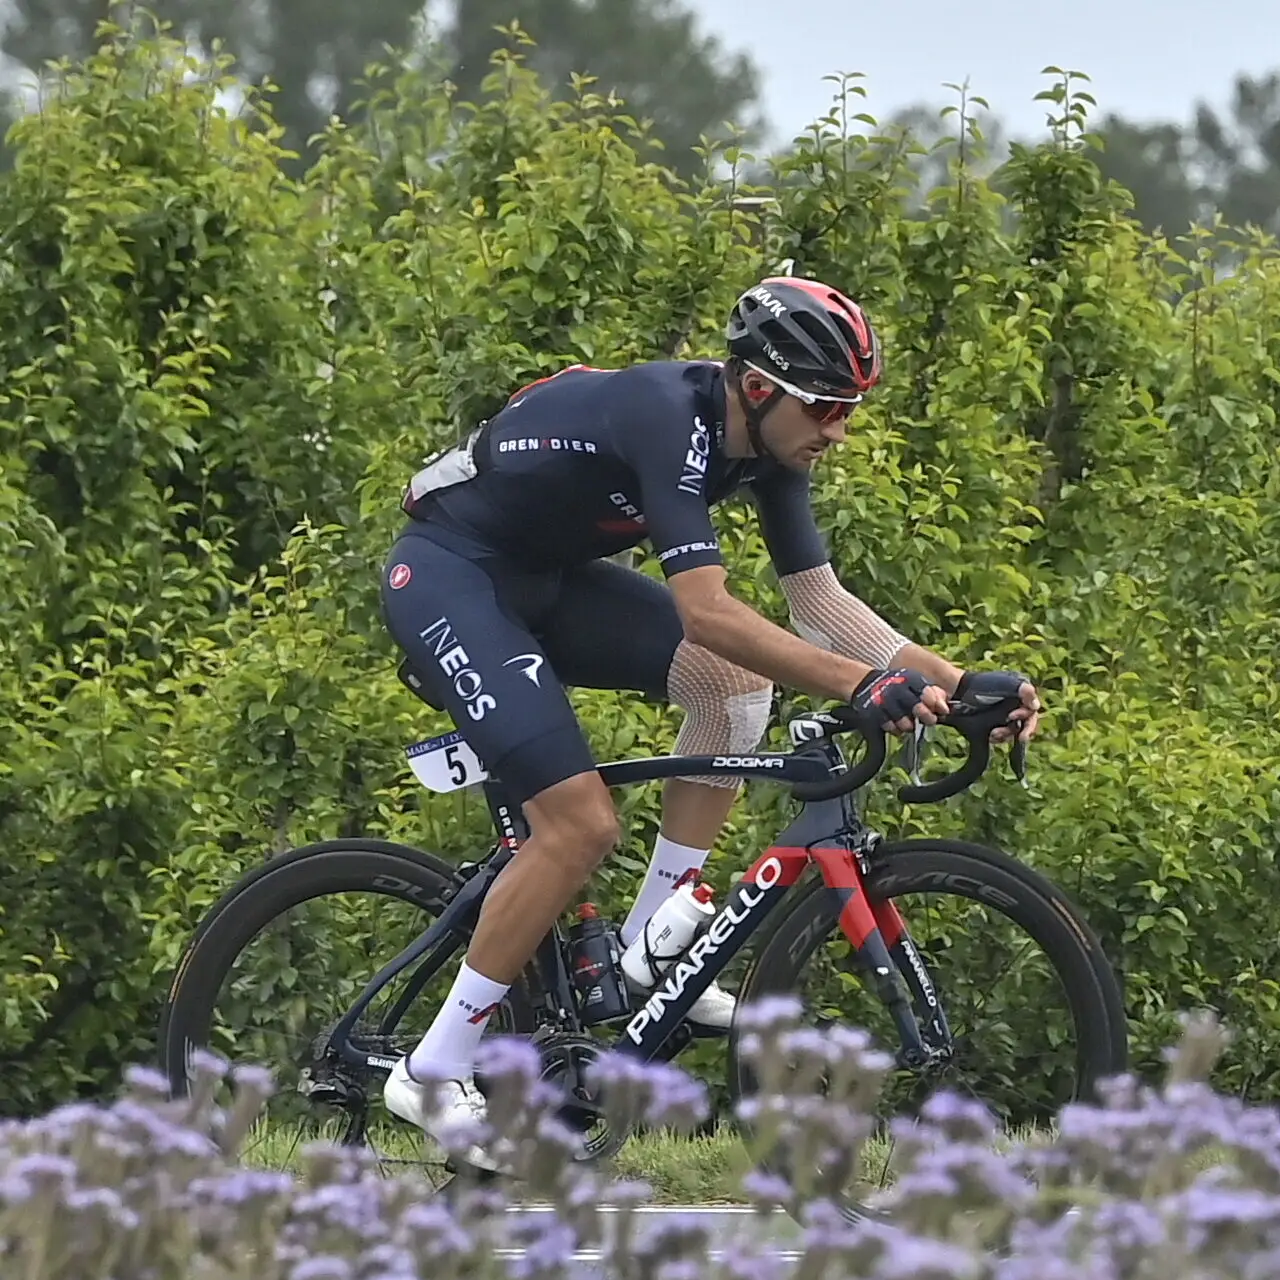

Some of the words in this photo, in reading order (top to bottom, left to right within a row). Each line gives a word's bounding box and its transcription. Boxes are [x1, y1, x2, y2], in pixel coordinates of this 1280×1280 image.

[499, 438, 597, 455] GRENADIER
[419, 616, 498, 722] INEOS
[444, 745, 468, 786] 5
[712, 756, 785, 769] DOGMA
[626, 856, 783, 1046] PINARELLO
[900, 940, 937, 1007] PINARELLO
[366, 1056, 397, 1070] SHIM
